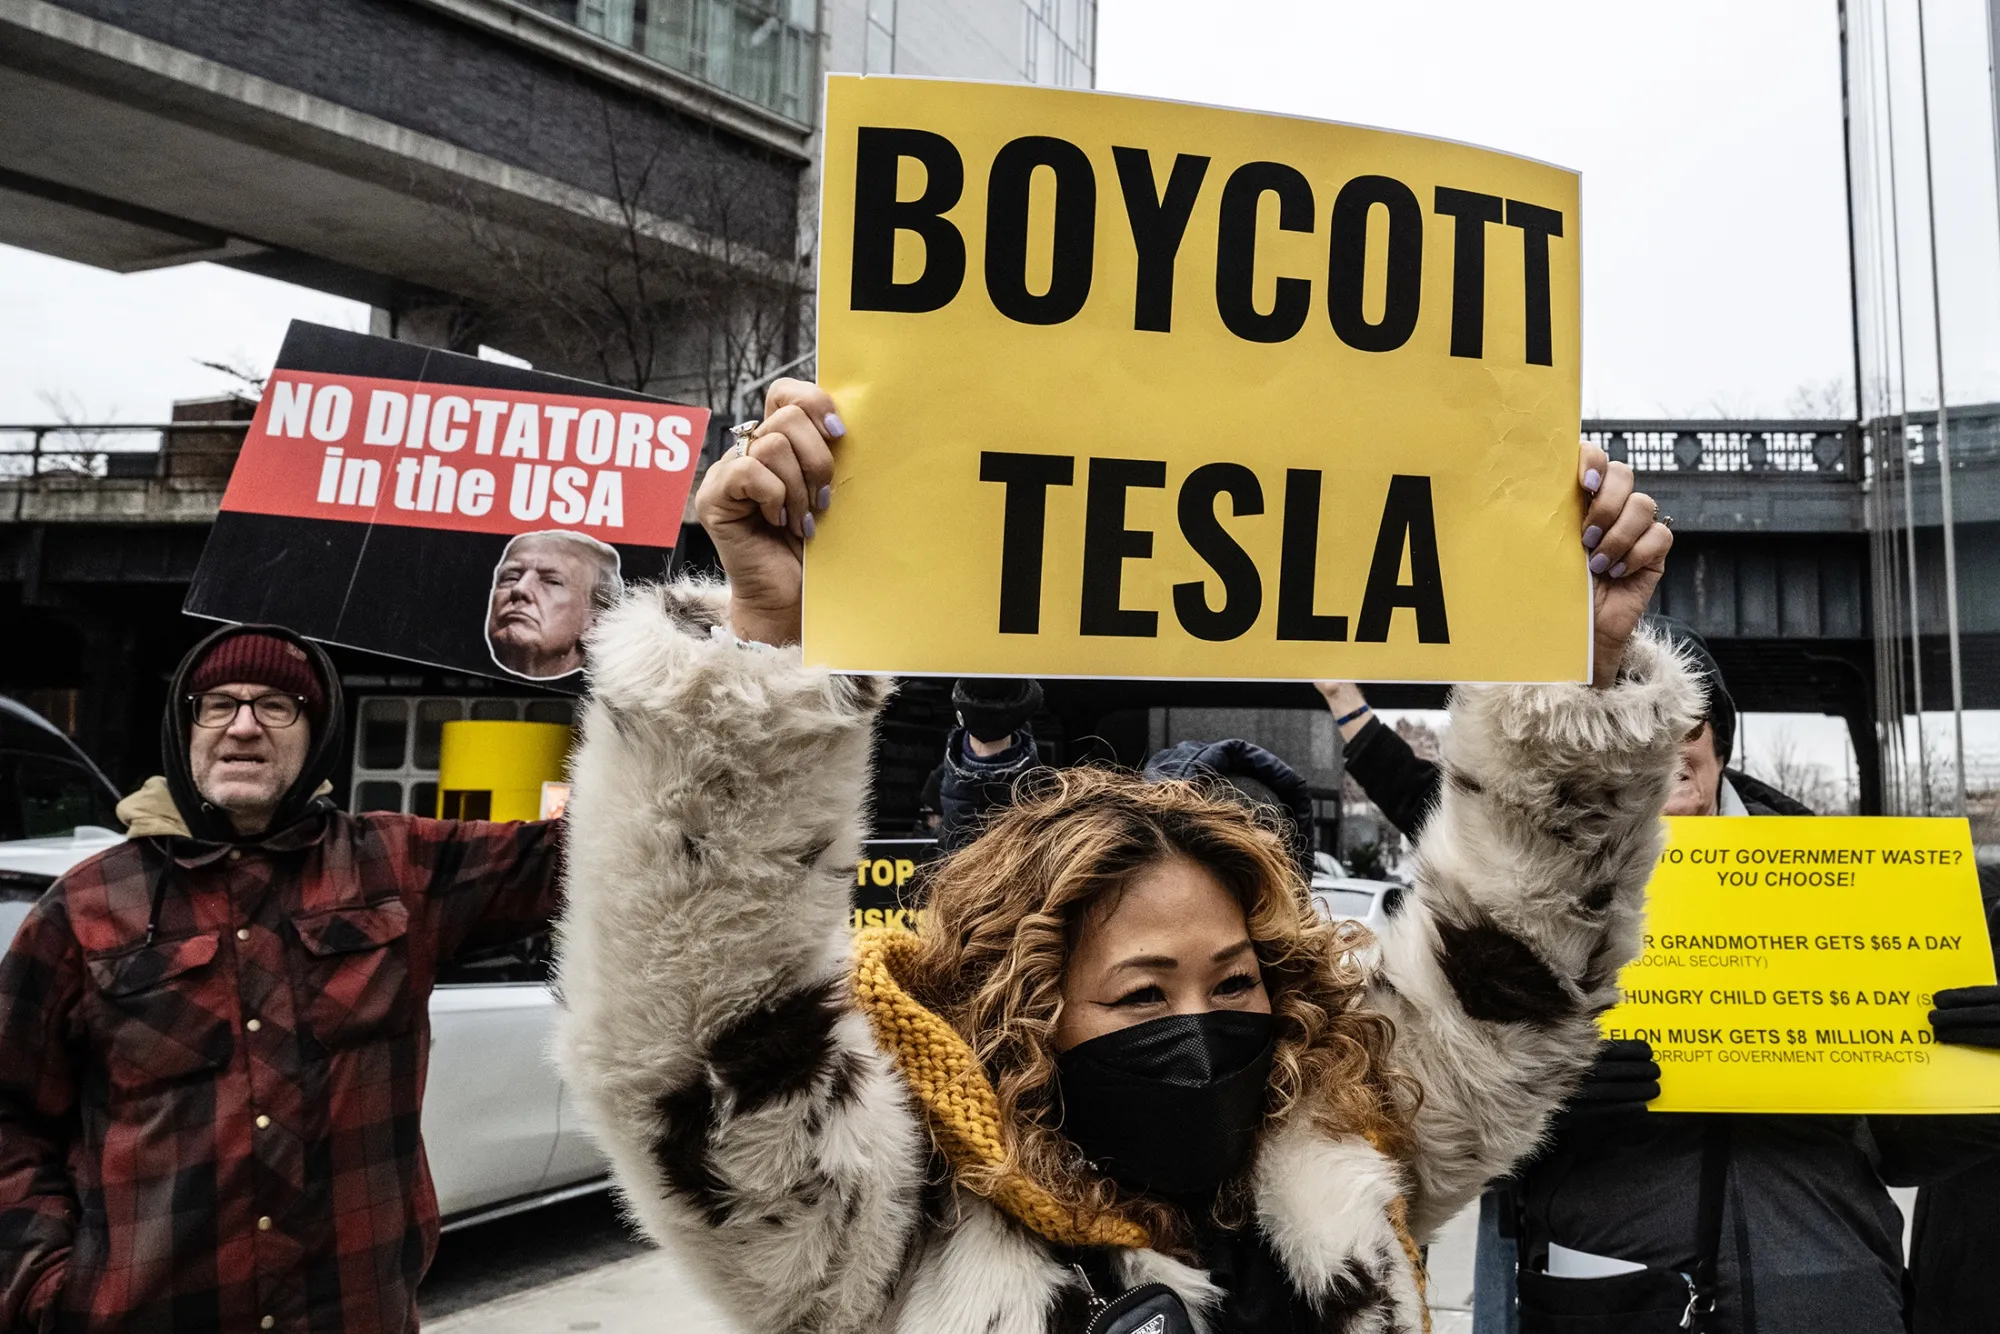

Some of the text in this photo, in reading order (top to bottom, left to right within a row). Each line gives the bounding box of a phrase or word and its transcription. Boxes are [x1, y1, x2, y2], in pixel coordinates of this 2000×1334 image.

[850, 126, 1563, 367] BOYCOTT
[266, 381, 692, 473] NO DICTATORS
[316, 446, 625, 528] in the USA
[979, 450, 1450, 644] TESLA
[1661, 849, 1963, 865] TO CUT GOVERNMENT WASTE?
[856, 858, 915, 887] TOP
[1717, 871, 1856, 887] YOU CHOOSE!
[1660, 934, 1809, 950] GRANDMOTHER
[1814, 935, 1865, 951] GETS
[1871, 935, 1902, 951] $65
[1907, 936, 1920, 950] A
[1925, 936, 1962, 951] DAY
[1689, 955, 1769, 970] SECURITY)
[1625, 990, 1703, 1005] HUNGRY
[1709, 990, 1767, 1006] CHILD
[1772, 990, 1824, 1006] GETS
[1829, 990, 1850, 1006] $6
[1855, 991, 1869, 1005] A
[1874, 991, 1910, 1006] DAY
[1668, 1029, 1723, 1044] MUSK
[1729, 1029, 1780, 1045] GETS
[1786, 1029, 1807, 1045] $8
[1816, 1029, 1893, 1045] MILLION
[1900, 1030, 1913, 1045] A
[1653, 1050, 1930, 1065] ORRUPT GOVERNMENT CONTRACTS)
